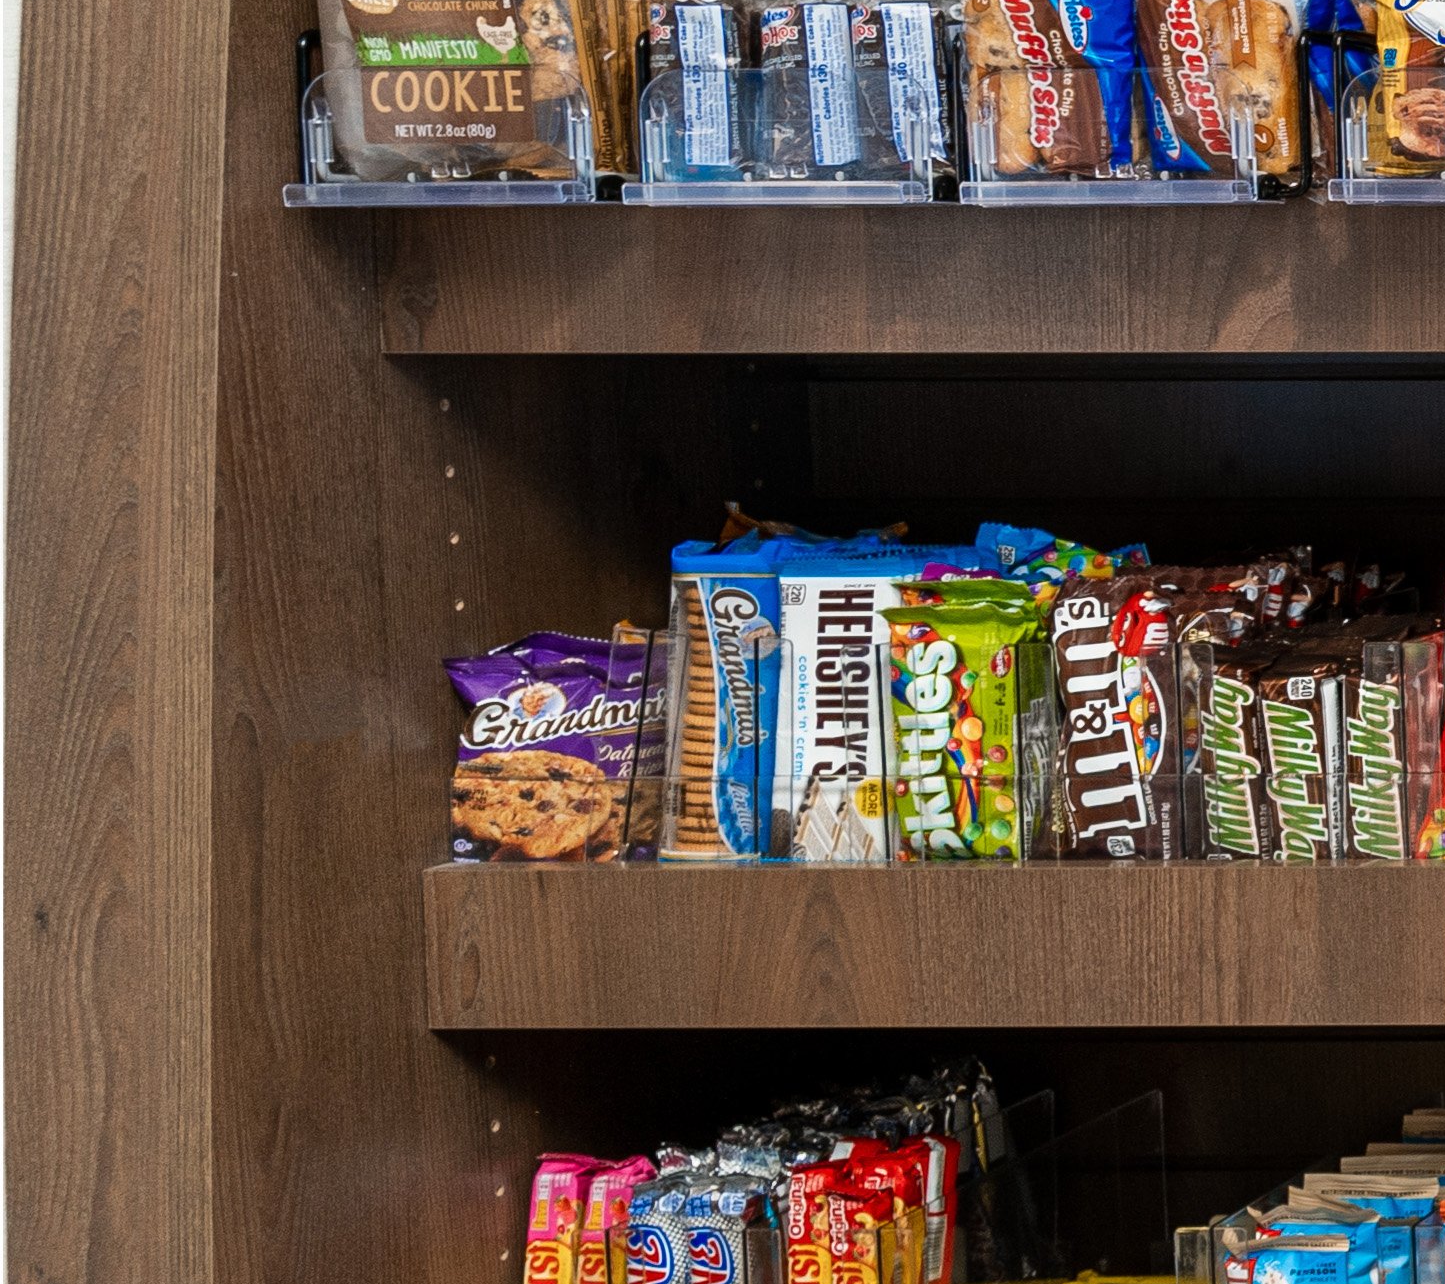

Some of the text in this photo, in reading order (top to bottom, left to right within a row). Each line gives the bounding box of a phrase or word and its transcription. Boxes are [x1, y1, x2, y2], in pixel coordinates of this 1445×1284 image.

[408, 1, 499, 11] CHOCOLATE CHUNK
[364, 37, 388, 48] NON
[399, 40, 478, 59] MANIFESTO
[370, 50, 391, 61] GMO
[370, 70, 525, 113] COOKIE
